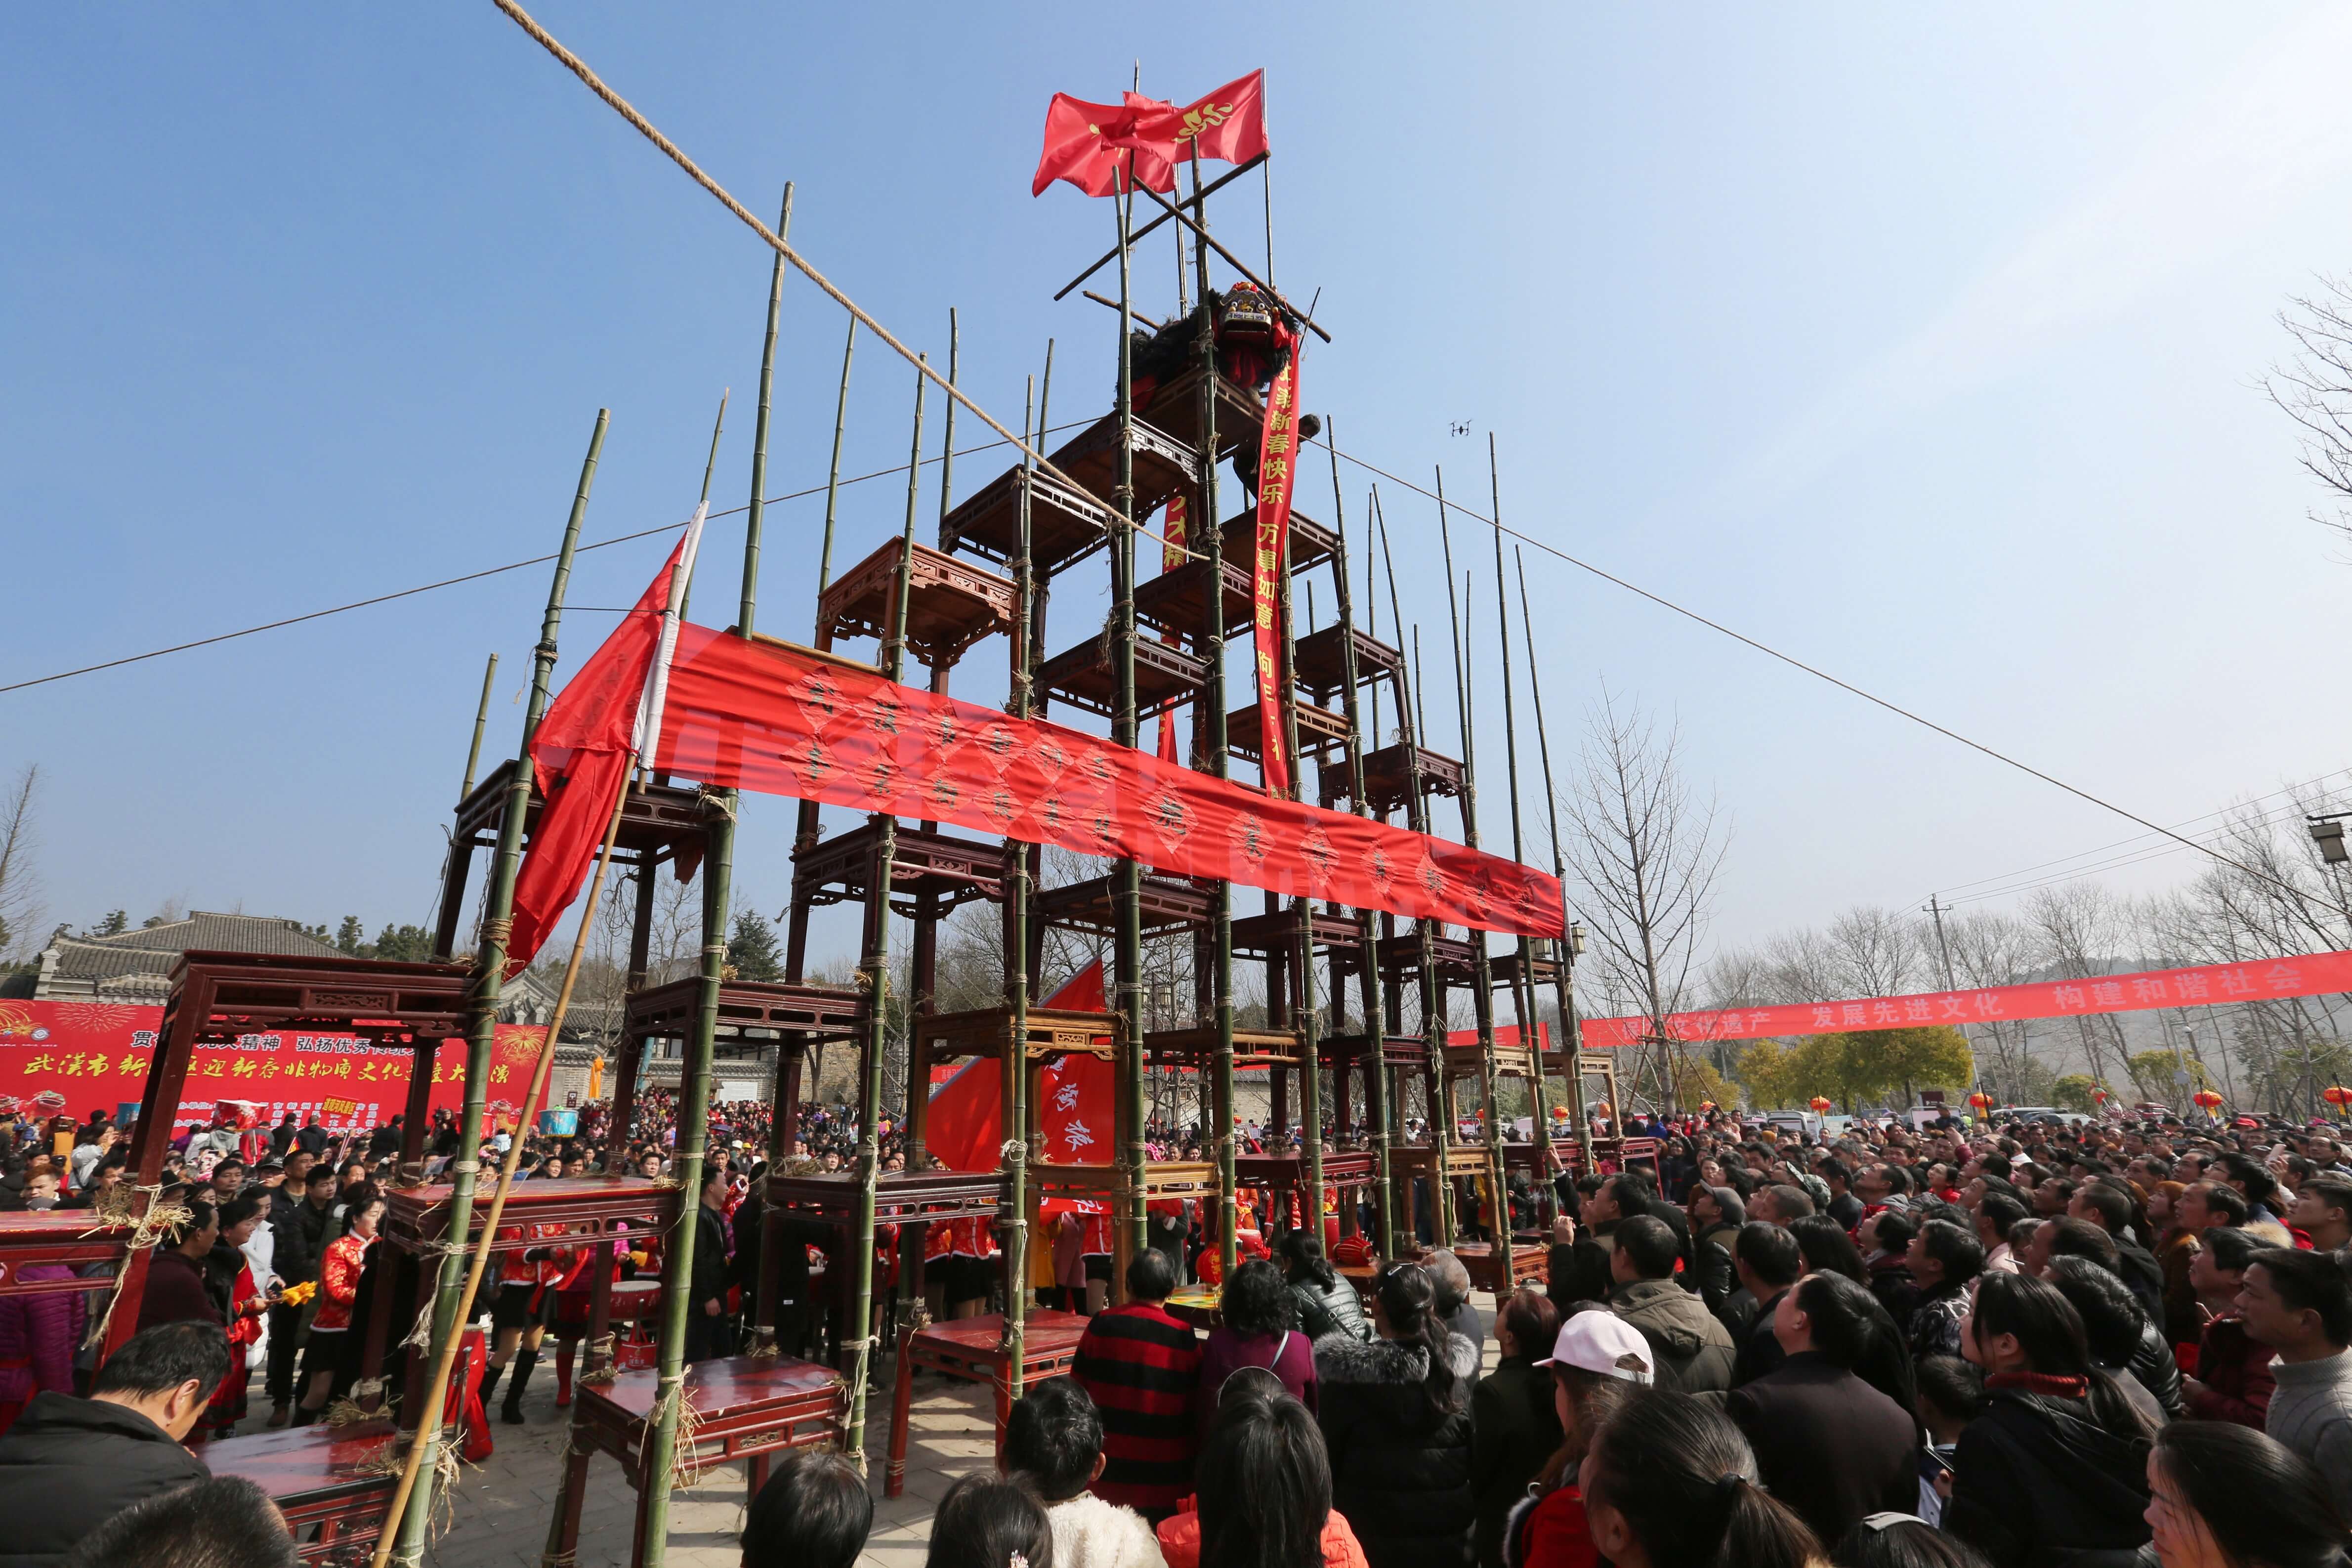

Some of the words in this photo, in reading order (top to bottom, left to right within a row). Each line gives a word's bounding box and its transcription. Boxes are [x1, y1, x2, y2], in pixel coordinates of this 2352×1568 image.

[1256, 522, 1279, 631] 万事如意
[1811, 991, 2004, 1028] 发展先进文化
[2054, 964, 2302, 1010] 构建和谐社会
